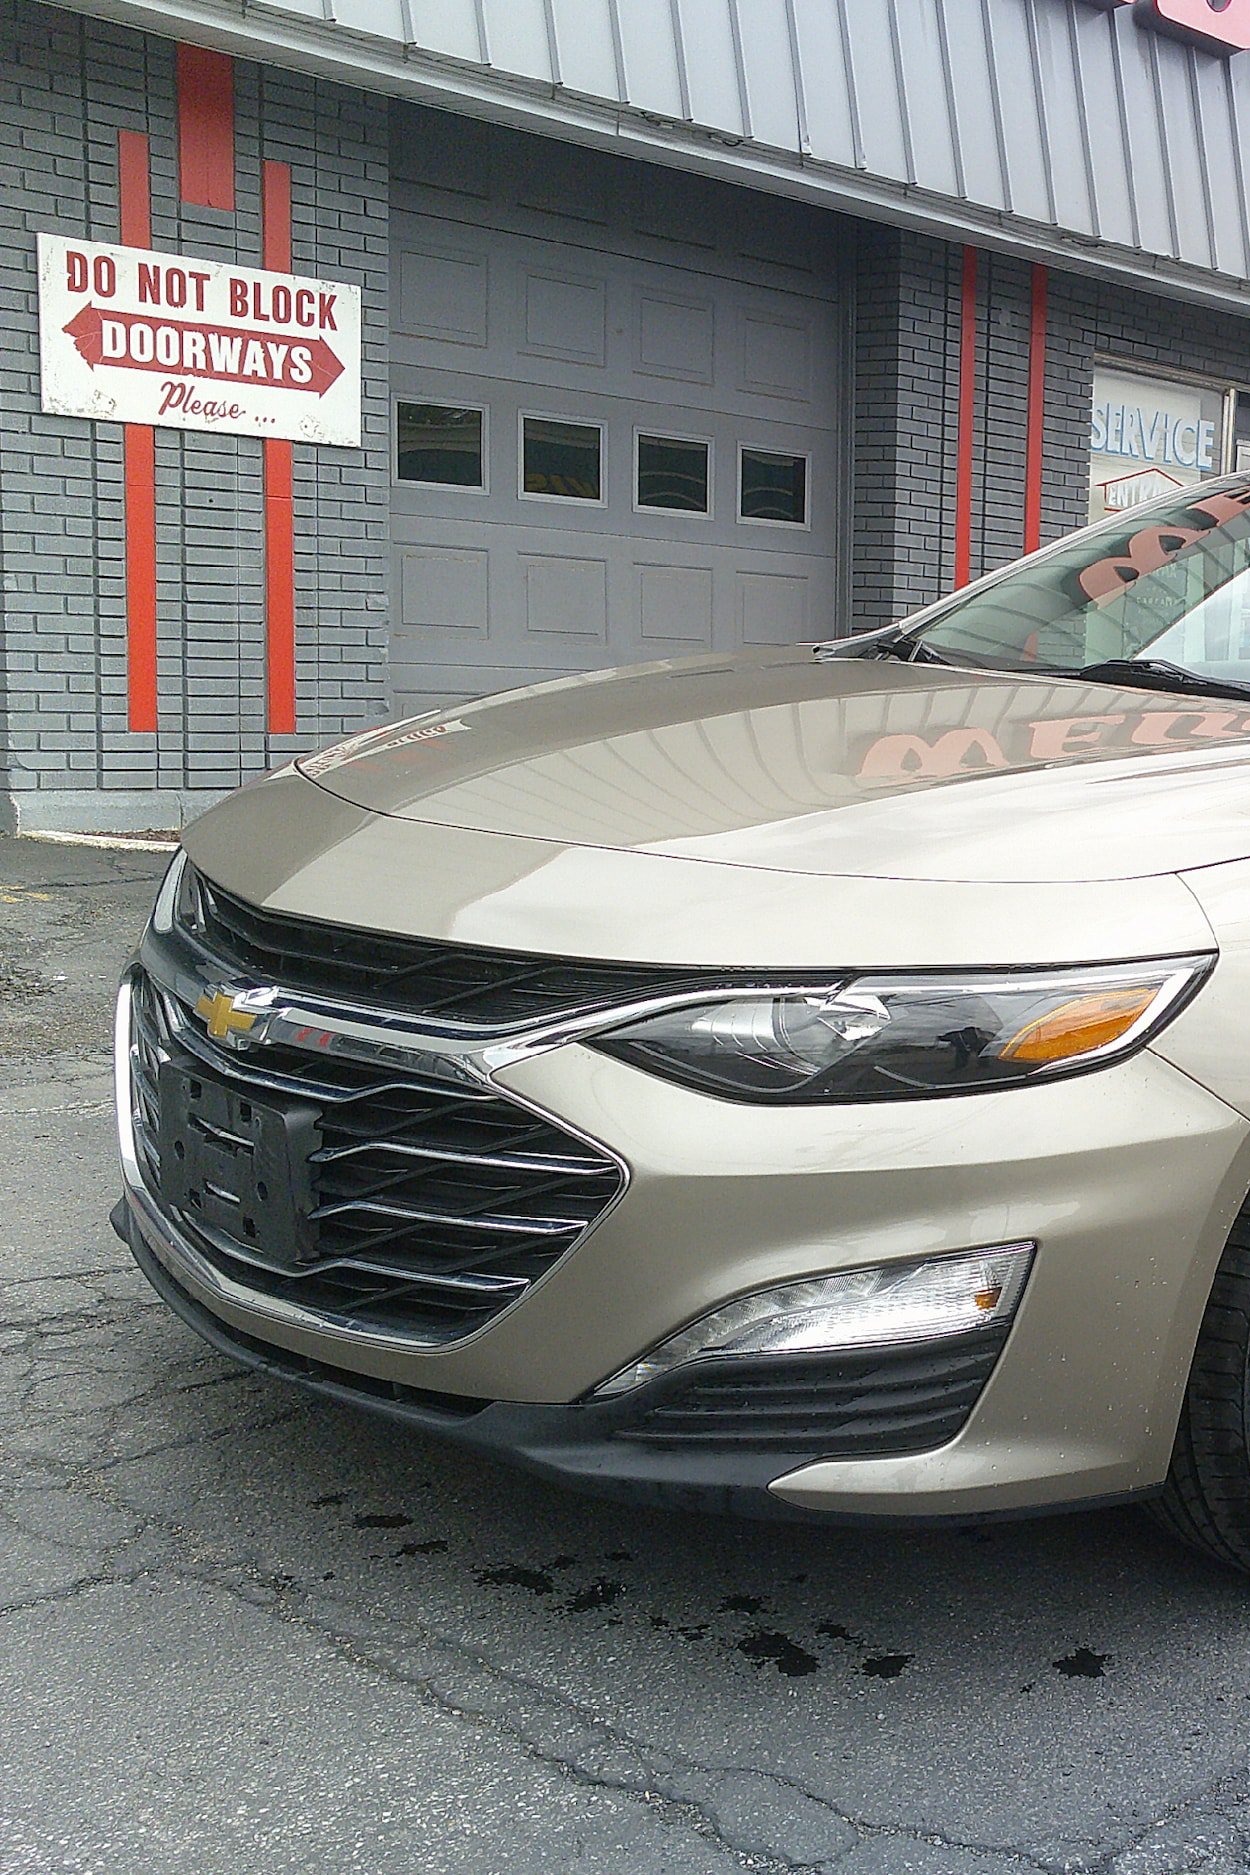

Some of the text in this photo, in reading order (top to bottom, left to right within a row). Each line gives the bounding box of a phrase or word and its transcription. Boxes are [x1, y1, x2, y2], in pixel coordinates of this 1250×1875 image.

[66, 250, 338, 331] DO NOT BLOCK
[102, 318, 313, 384] DOORWAYS
[1090, 403, 1215, 470] SERVICE
